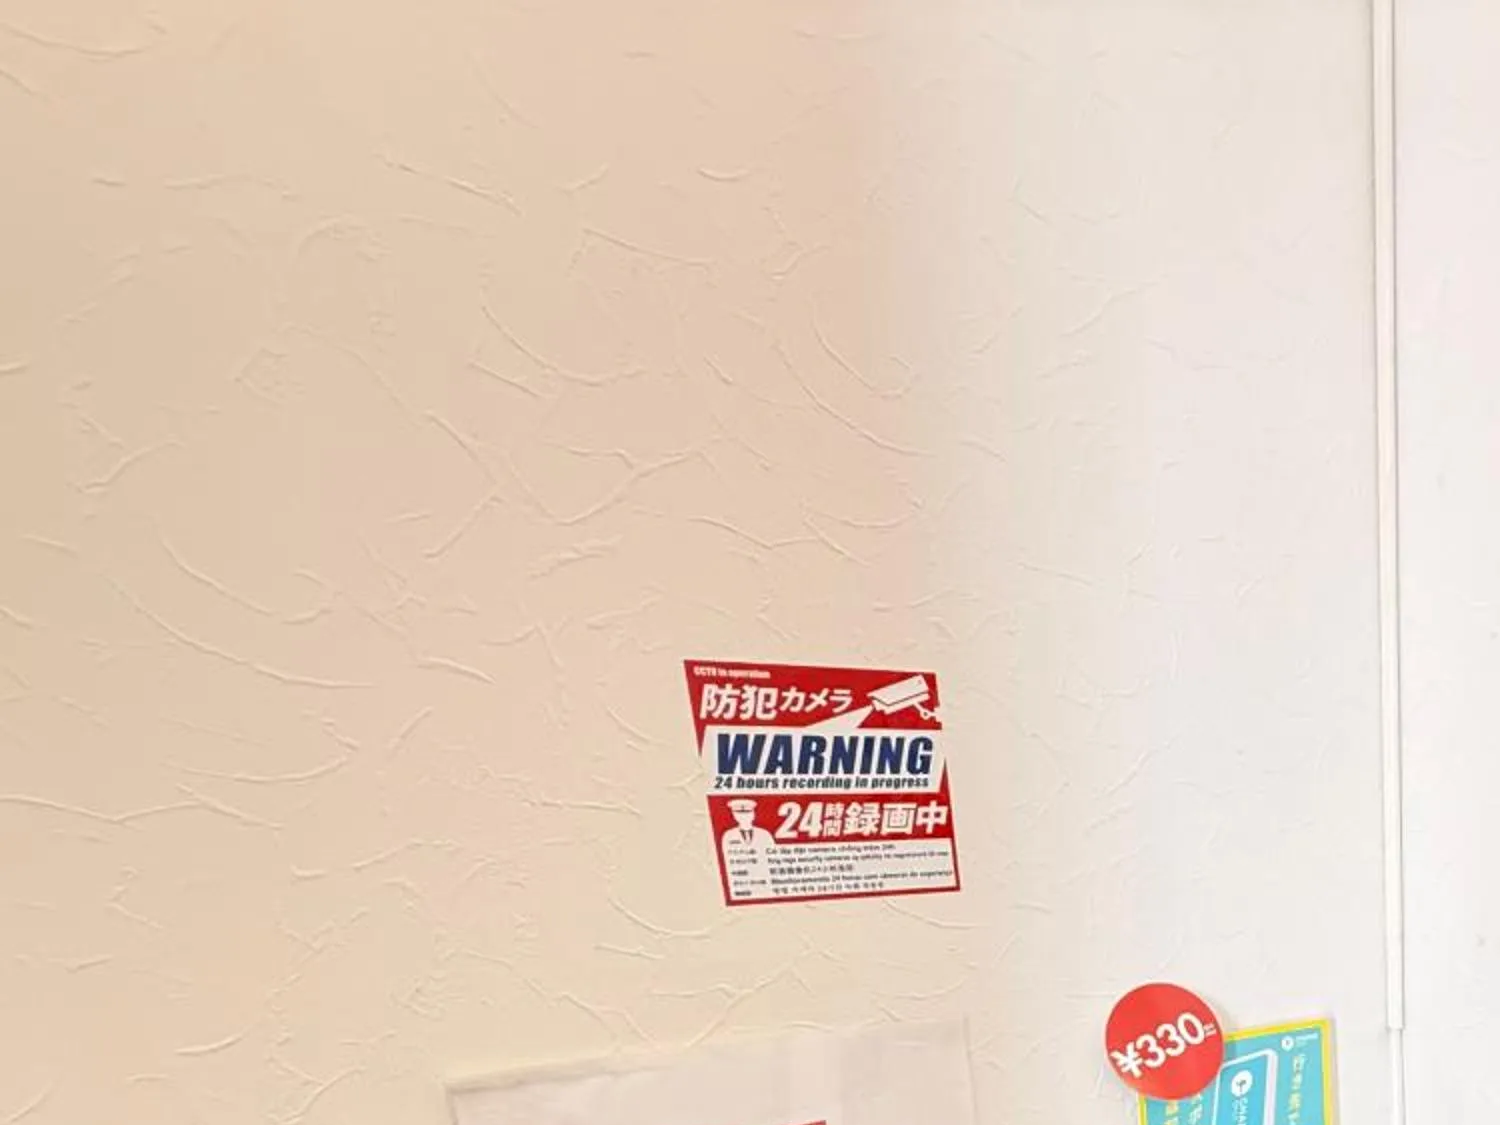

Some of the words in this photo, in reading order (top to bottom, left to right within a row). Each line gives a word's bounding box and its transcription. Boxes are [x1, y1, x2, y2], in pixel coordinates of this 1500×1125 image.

[700, 683, 853, 720] 防犯カメラ
[717, 733, 933, 775] WARNING
[714, 777, 733, 789] 24
[736, 777, 779, 789] hours
[782, 777, 851, 790] recording
[855, 777, 868, 788] in
[871, 777, 929, 790] progress
